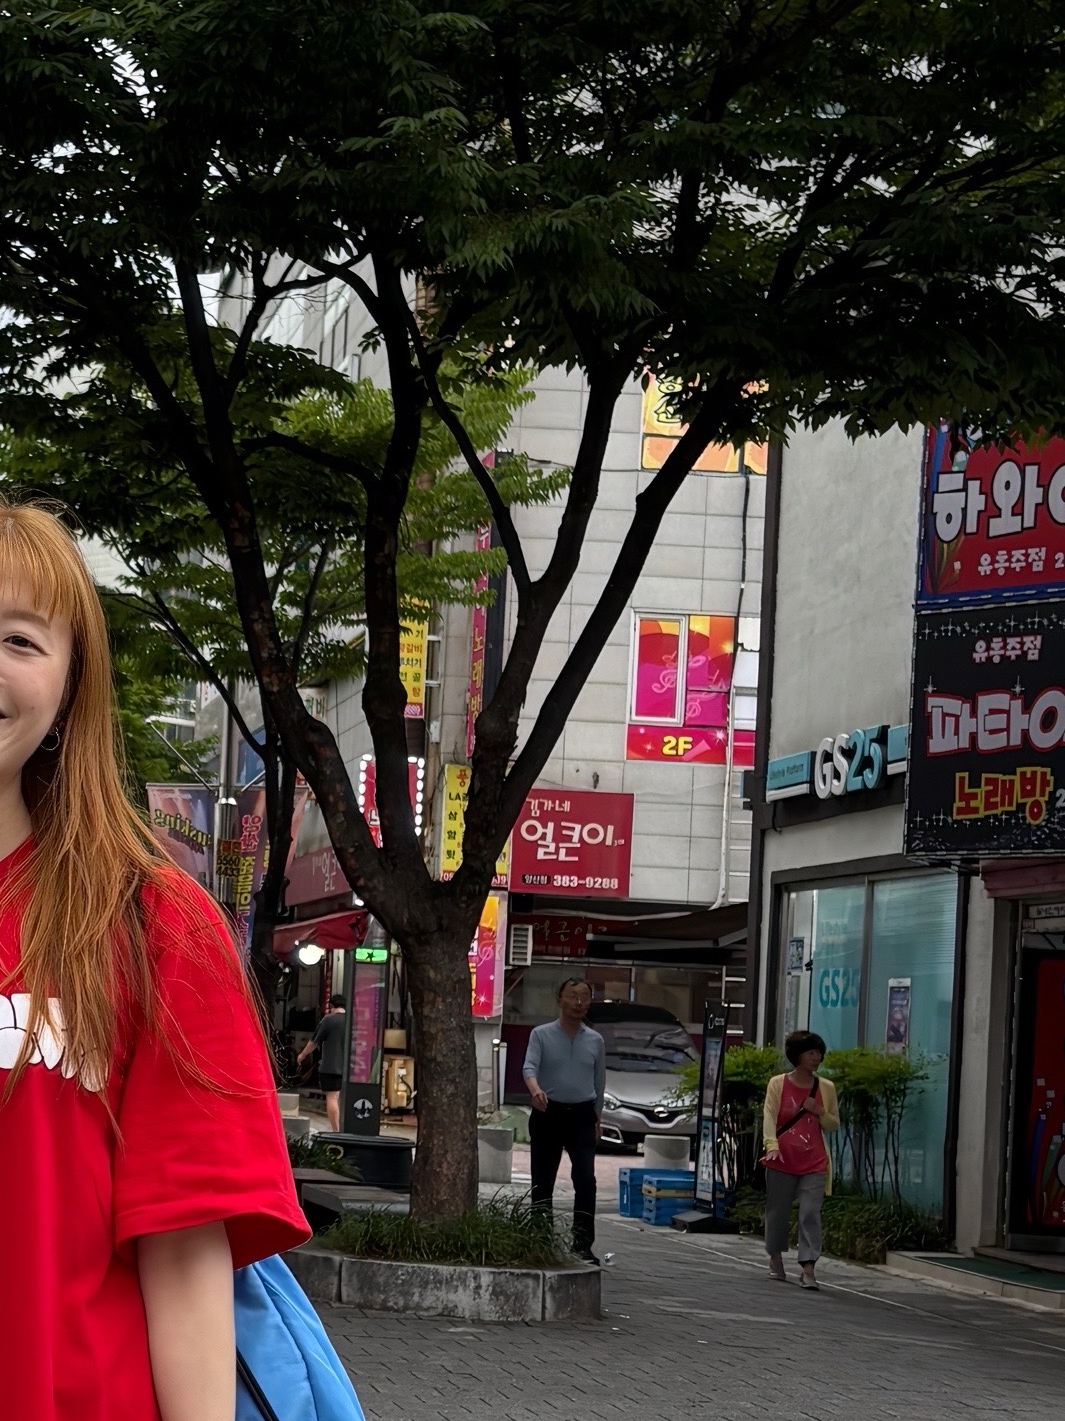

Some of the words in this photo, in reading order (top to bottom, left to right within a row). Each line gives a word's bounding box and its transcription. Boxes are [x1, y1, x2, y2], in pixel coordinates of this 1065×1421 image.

[978, 547, 1046, 576] 유흥주점
[972, 635, 1042, 664] 유흥주점
[662, 735, 694, 757] 2F
[815, 726, 883, 799] GS25
[526, 799, 571, 818] 김가네
[953, 767, 1054, 825] 노래방
[520, 819, 614, 862] 얼큰이
